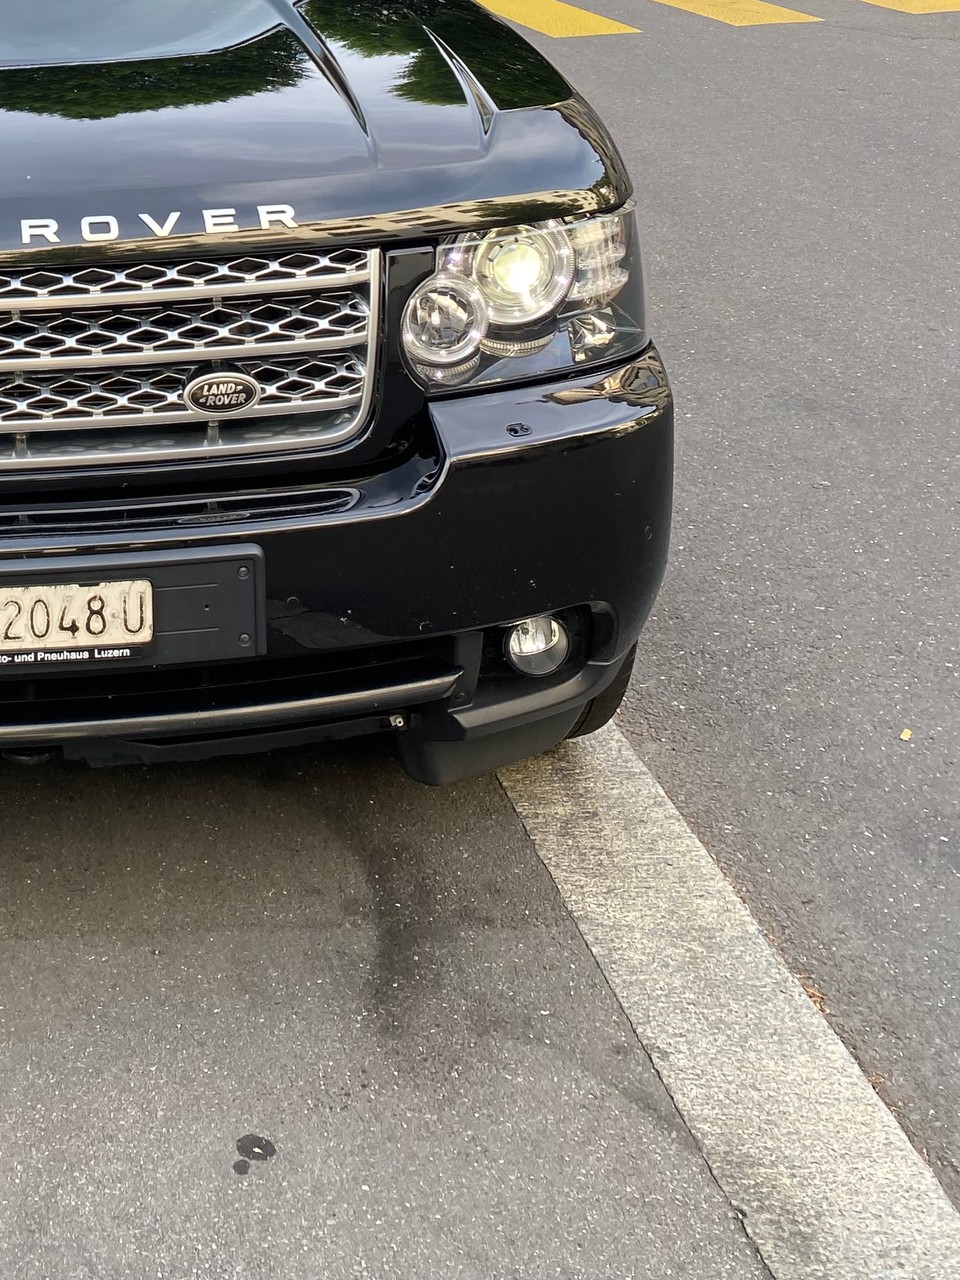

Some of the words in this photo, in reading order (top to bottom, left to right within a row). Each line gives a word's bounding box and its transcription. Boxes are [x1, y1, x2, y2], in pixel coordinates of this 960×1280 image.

[19, 202, 299, 246] ROVER
[202, 382, 236, 396] LAND
[205, 392, 247, 406] ROVER
[14, 653, 35, 663] und
[37, 650, 90, 662] Pneuhaus
[94, 648, 131, 658] Luzern
